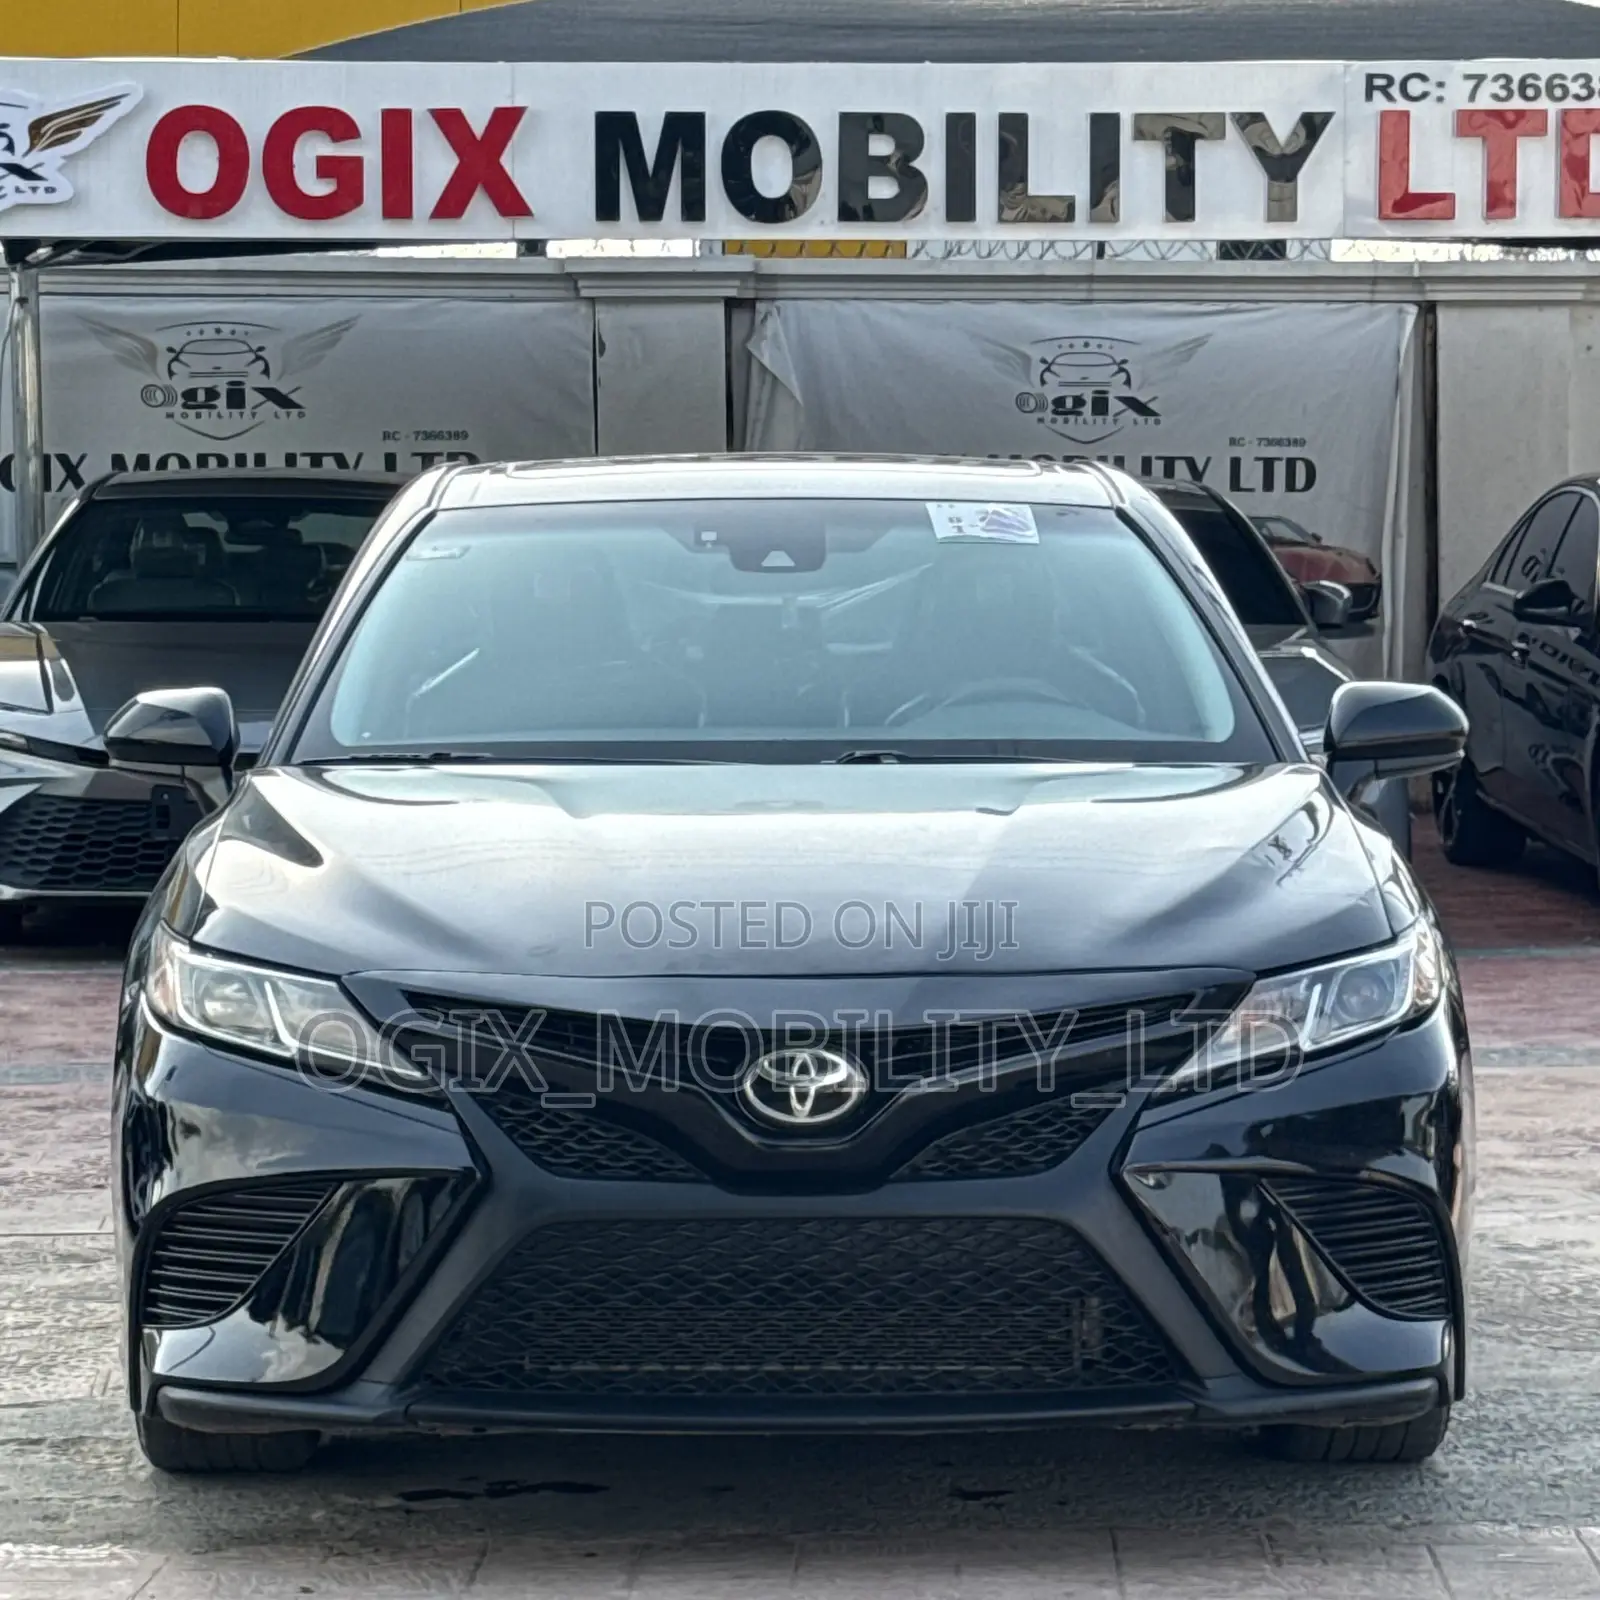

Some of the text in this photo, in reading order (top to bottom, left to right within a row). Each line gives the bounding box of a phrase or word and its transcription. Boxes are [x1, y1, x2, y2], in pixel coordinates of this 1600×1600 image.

[1364, 72, 1600, 103] RC: 73663
[146, 104, 534, 221] OGIX
[595, 110, 1336, 224] MOBILITY
[14, 185, 58, 195] LTD
[165, 410, 306, 420] MOBILITY LTD
[1037, 416, 1120, 426] MOBILITY
[382, 430, 401, 441] RC
[1229, 456, 1317, 493] LTD
